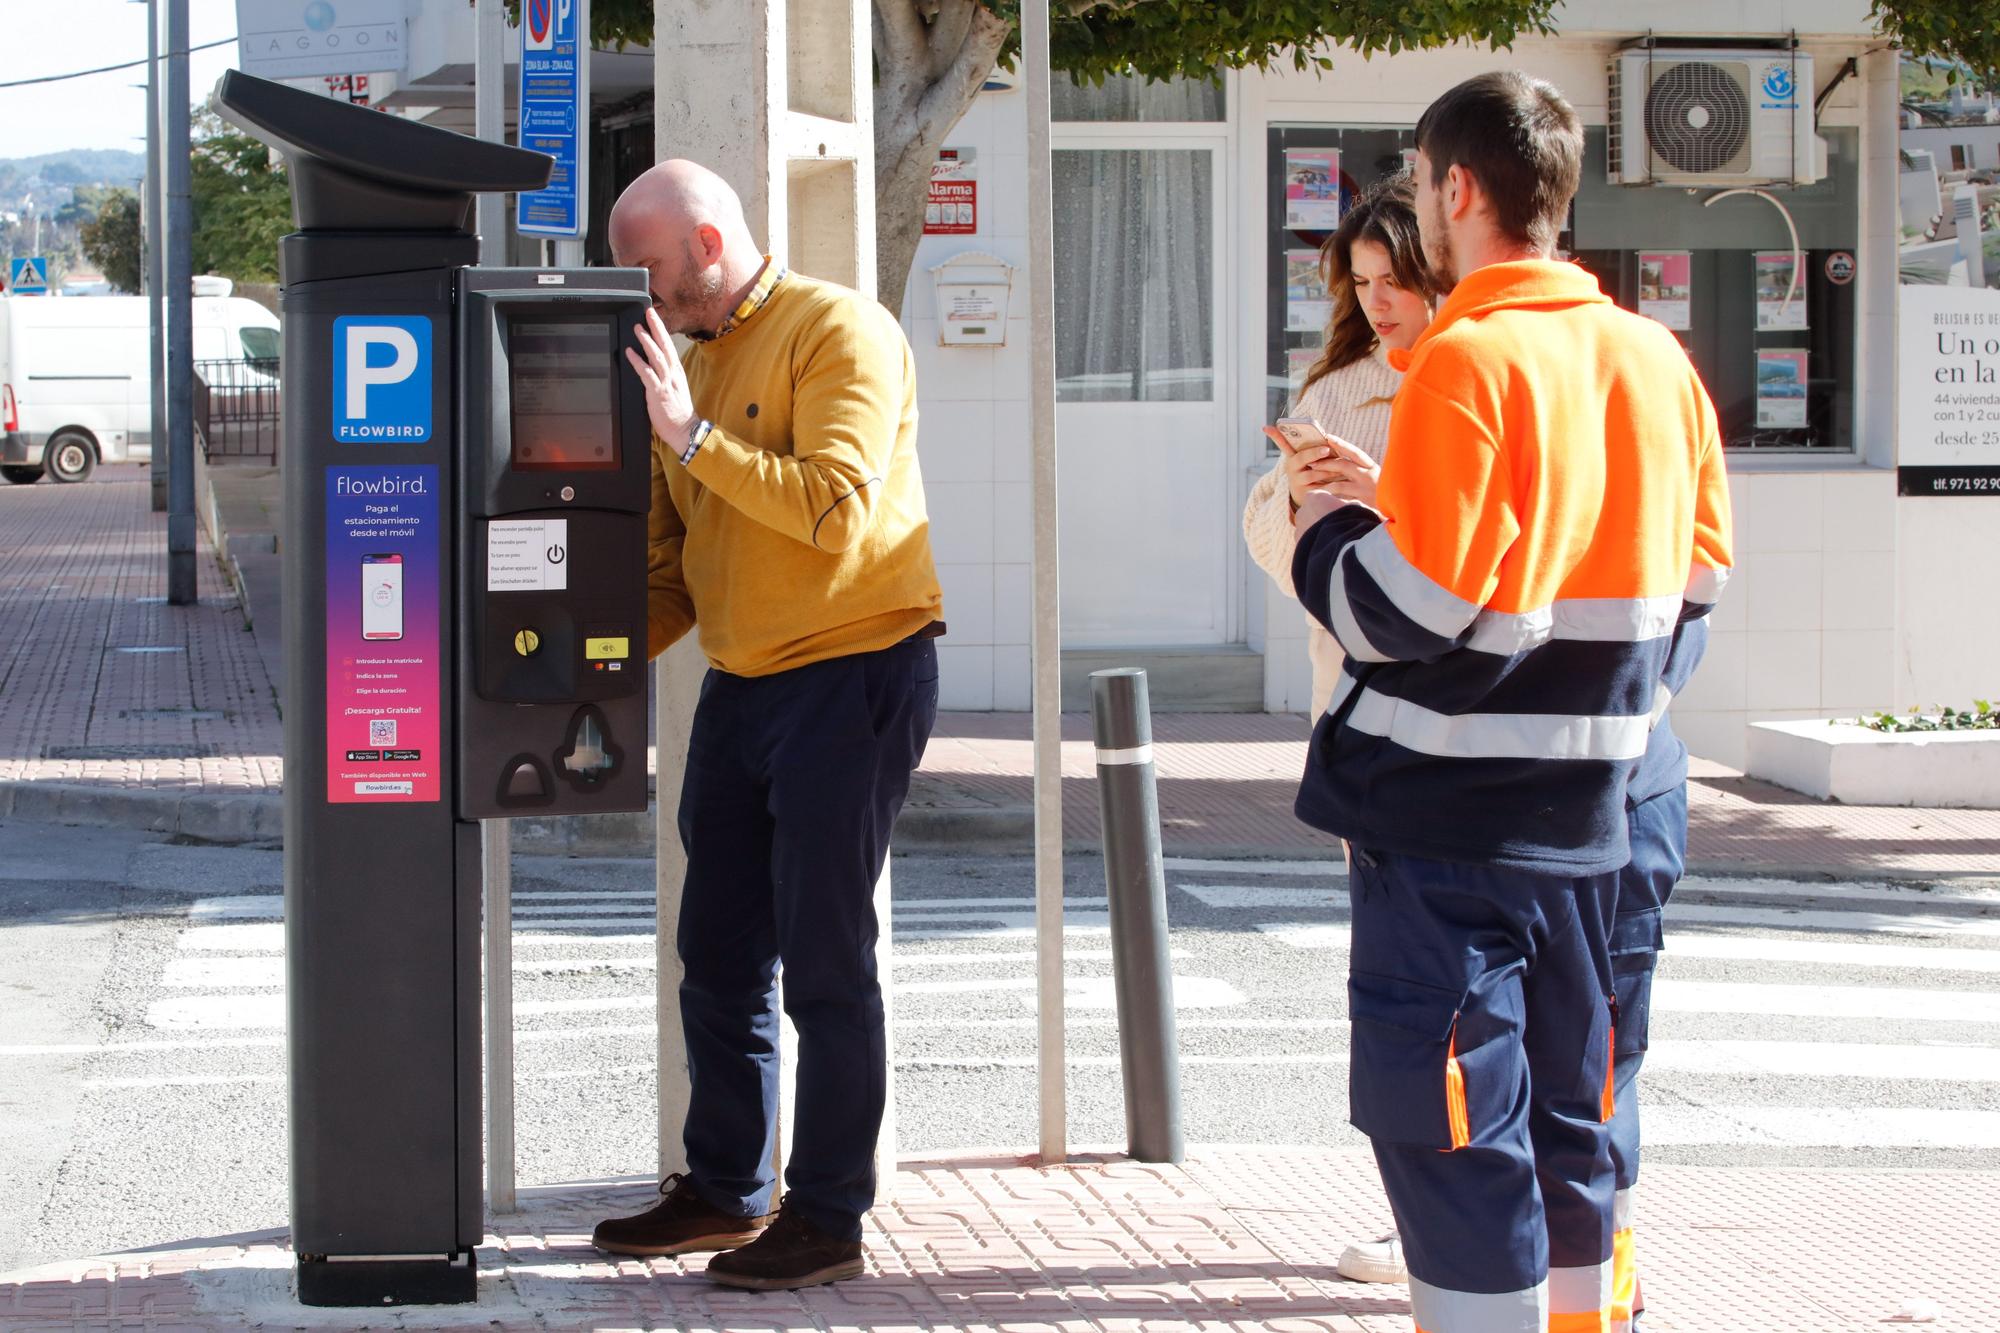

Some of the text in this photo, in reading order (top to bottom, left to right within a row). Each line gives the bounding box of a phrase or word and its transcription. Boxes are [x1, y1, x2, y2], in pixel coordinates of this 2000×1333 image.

[558, 0, 570, 35] P
[245, 30, 397, 54] LAGOON
[928, 182, 973, 195] Alarma
[1934, 313, 1970, 325] BELISLA
[1974, 313, 1984, 325] ES
[1936, 332, 2000, 355] Un o
[346, 326, 418, 419] P
[1935, 359, 1996, 383] en la
[1934, 394, 1950, 405] 44
[1934, 409, 2000, 423] con 1 y 2 cu
[340, 426, 424, 436] FLOWBIRD
[1934, 431, 1999, 445] desde 25
[337, 476, 427, 494] flowbird.
[1933, 478, 1948, 490] tlf.
[1950, 478, 1971, 490] 971
[1973, 478, 1988, 490] 92
[366, 504, 398, 514] Paga el
[344, 516, 420, 525] estacionamiento
[350, 528, 415, 537] desde el móvil
[345, 707, 384, 715] ¡Descarga
[369, 772, 401, 780] disponible
